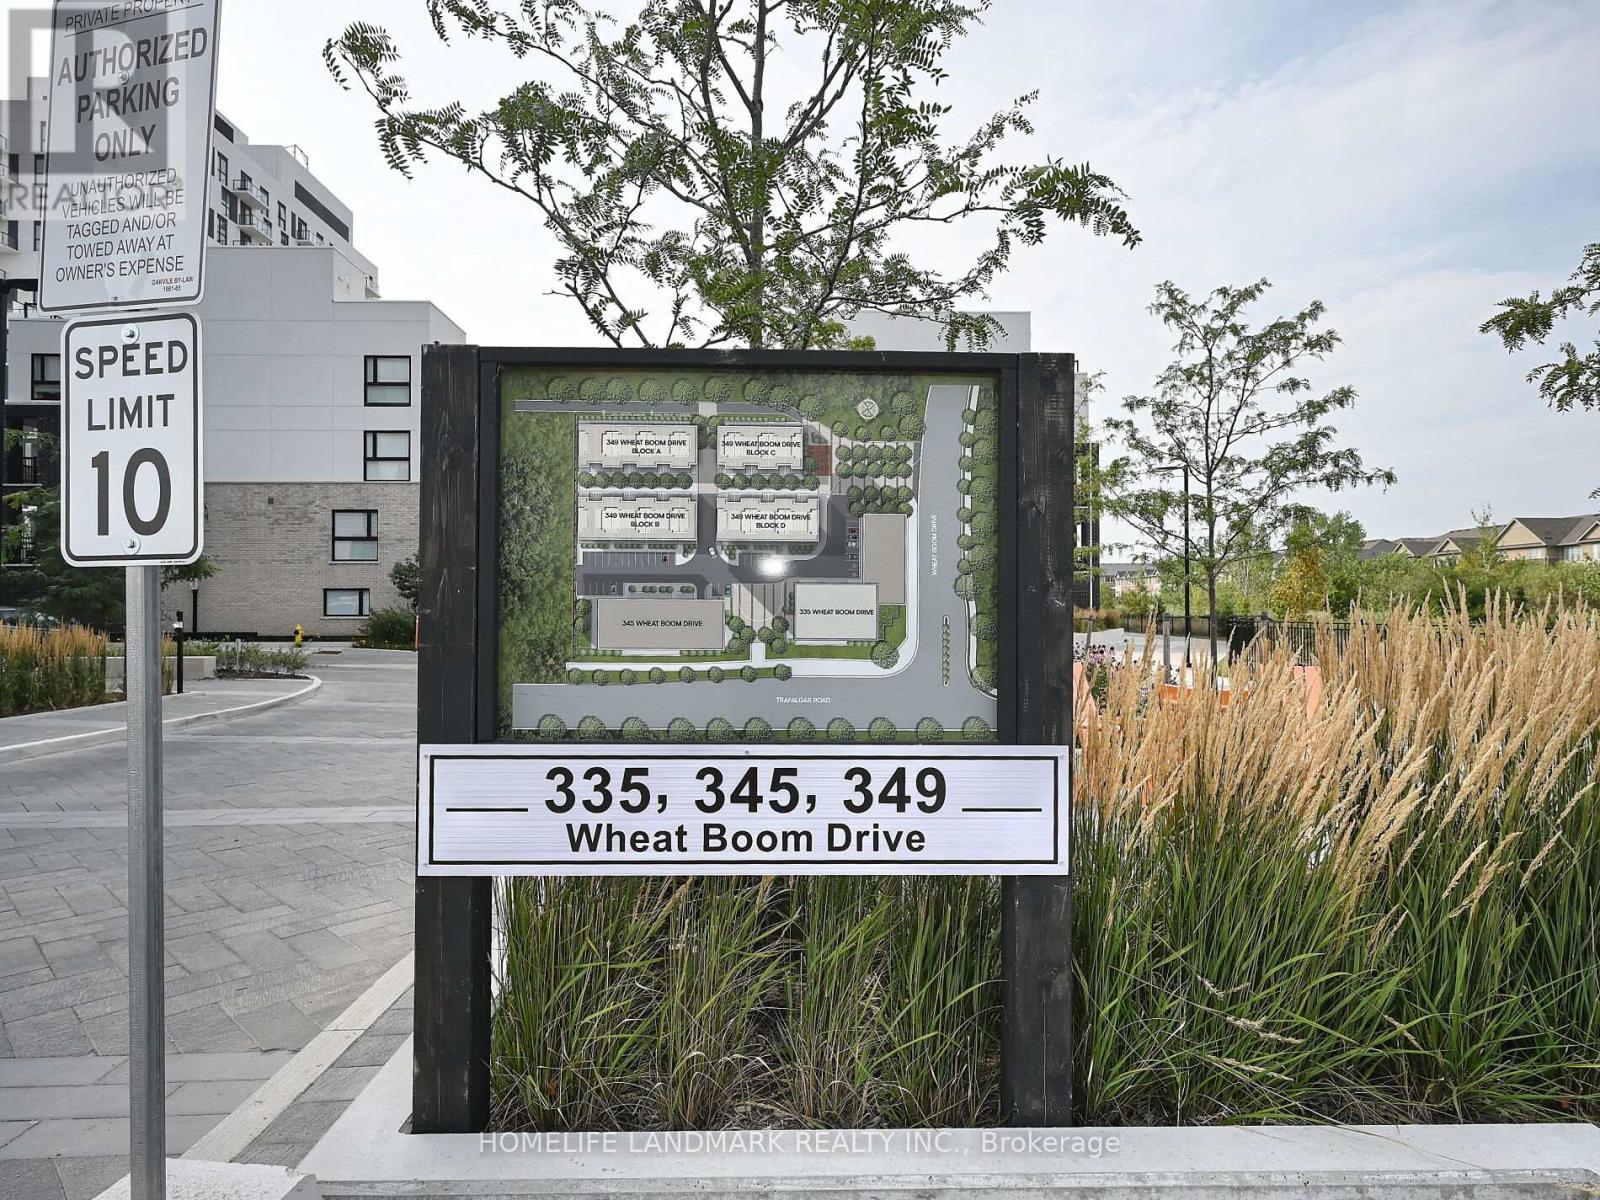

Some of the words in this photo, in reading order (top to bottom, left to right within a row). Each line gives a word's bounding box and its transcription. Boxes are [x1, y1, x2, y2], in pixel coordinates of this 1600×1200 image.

[65, 5, 120, 32] PRIVATE
[58, 27, 208, 86] AUTHORIZED
[77, 77, 180, 123] PARKING
[95, 124, 156, 162] ONLY
[71, 168, 177, 197] UNAUTHORIZED
[62, 196, 126, 219] VEHICLES
[129, 191, 161, 214] WILL
[166, 188, 184, 206] BE
[67, 219, 120, 239] TAGGED
[123, 212, 177, 234] AND/OR
[67, 242, 114, 260] TOWED
[116, 236, 156, 256] AWAY
[156, 234, 175, 251] AT
[56, 262, 115, 283] OWNER'S
[119, 255, 185, 277] EXPENSE
[75, 339, 188, 380] SPEED
[88, 394, 175, 431] LIMIT
[91, 447, 172, 536] 10
[545, 766, 668, 814] 335,
[695, 766, 817, 814] 345,
[843, 766, 947, 814] 349
[566, 823, 688, 853] Wheat
[703, 823, 813, 853] Boom
[828, 823, 926, 853] Drive
